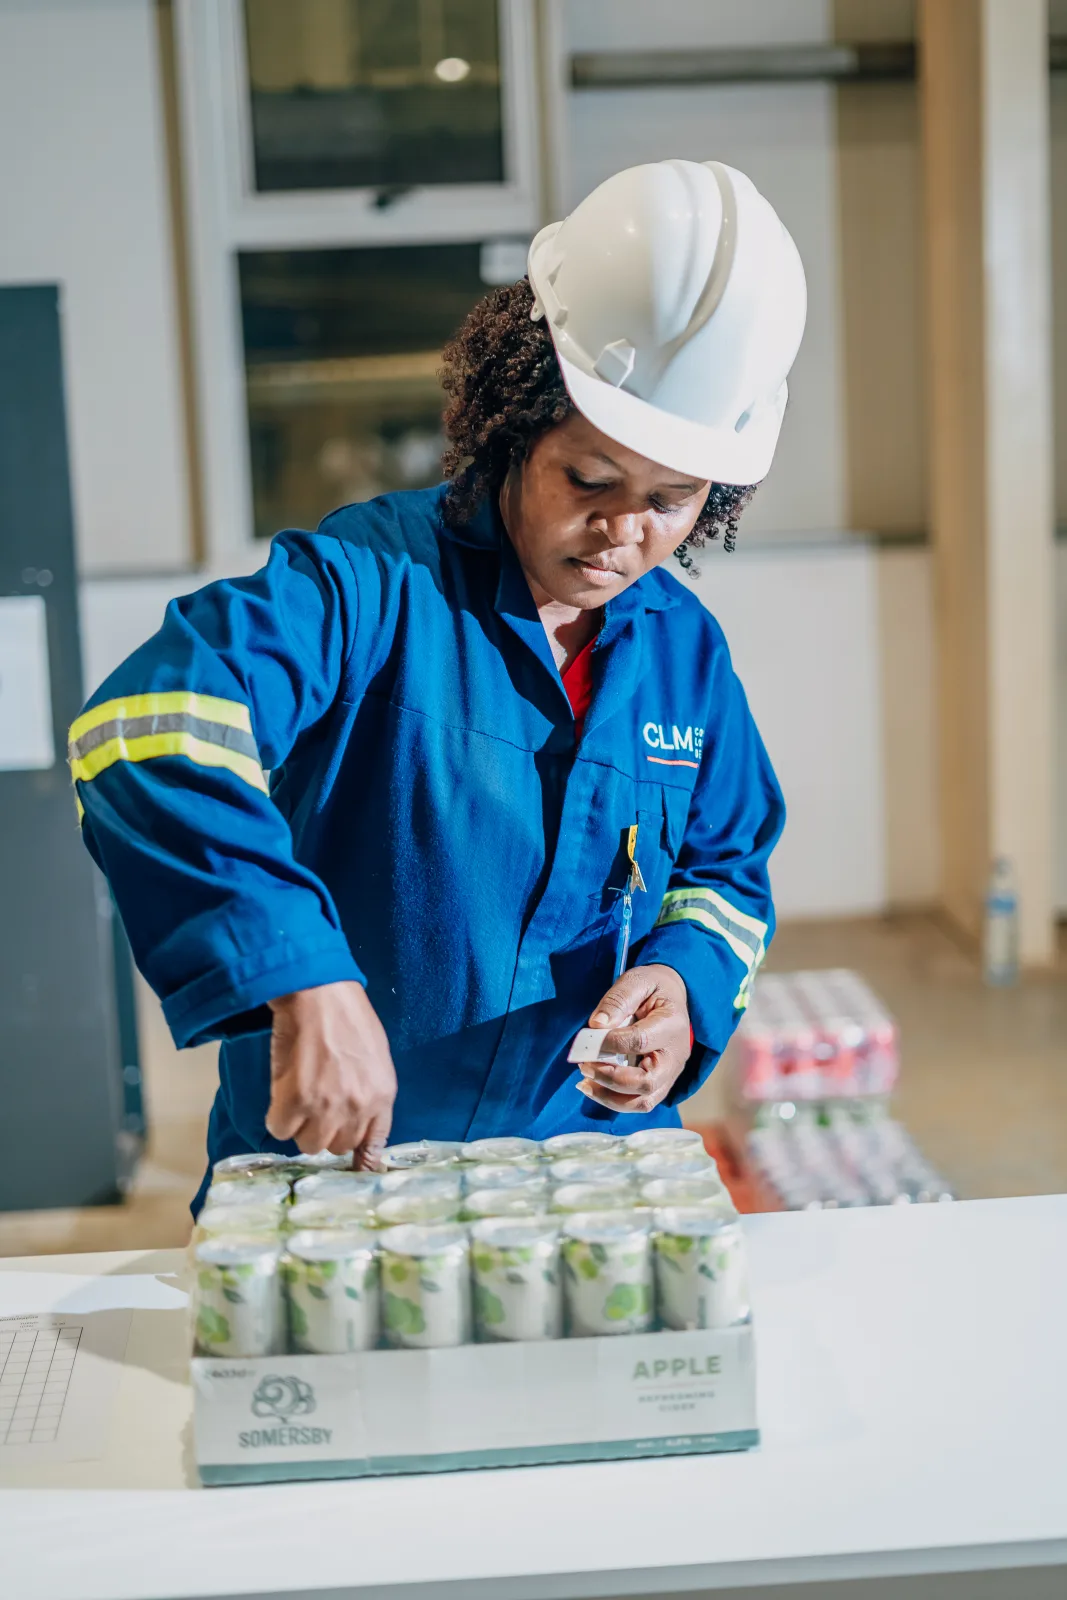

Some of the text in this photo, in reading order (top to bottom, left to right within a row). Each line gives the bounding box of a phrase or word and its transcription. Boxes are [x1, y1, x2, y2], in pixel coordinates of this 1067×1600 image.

[643, 722, 694, 752] CLM
[633, 1355, 722, 1381] APPLE
[238, 1426, 333, 1448] SOMERSBY
